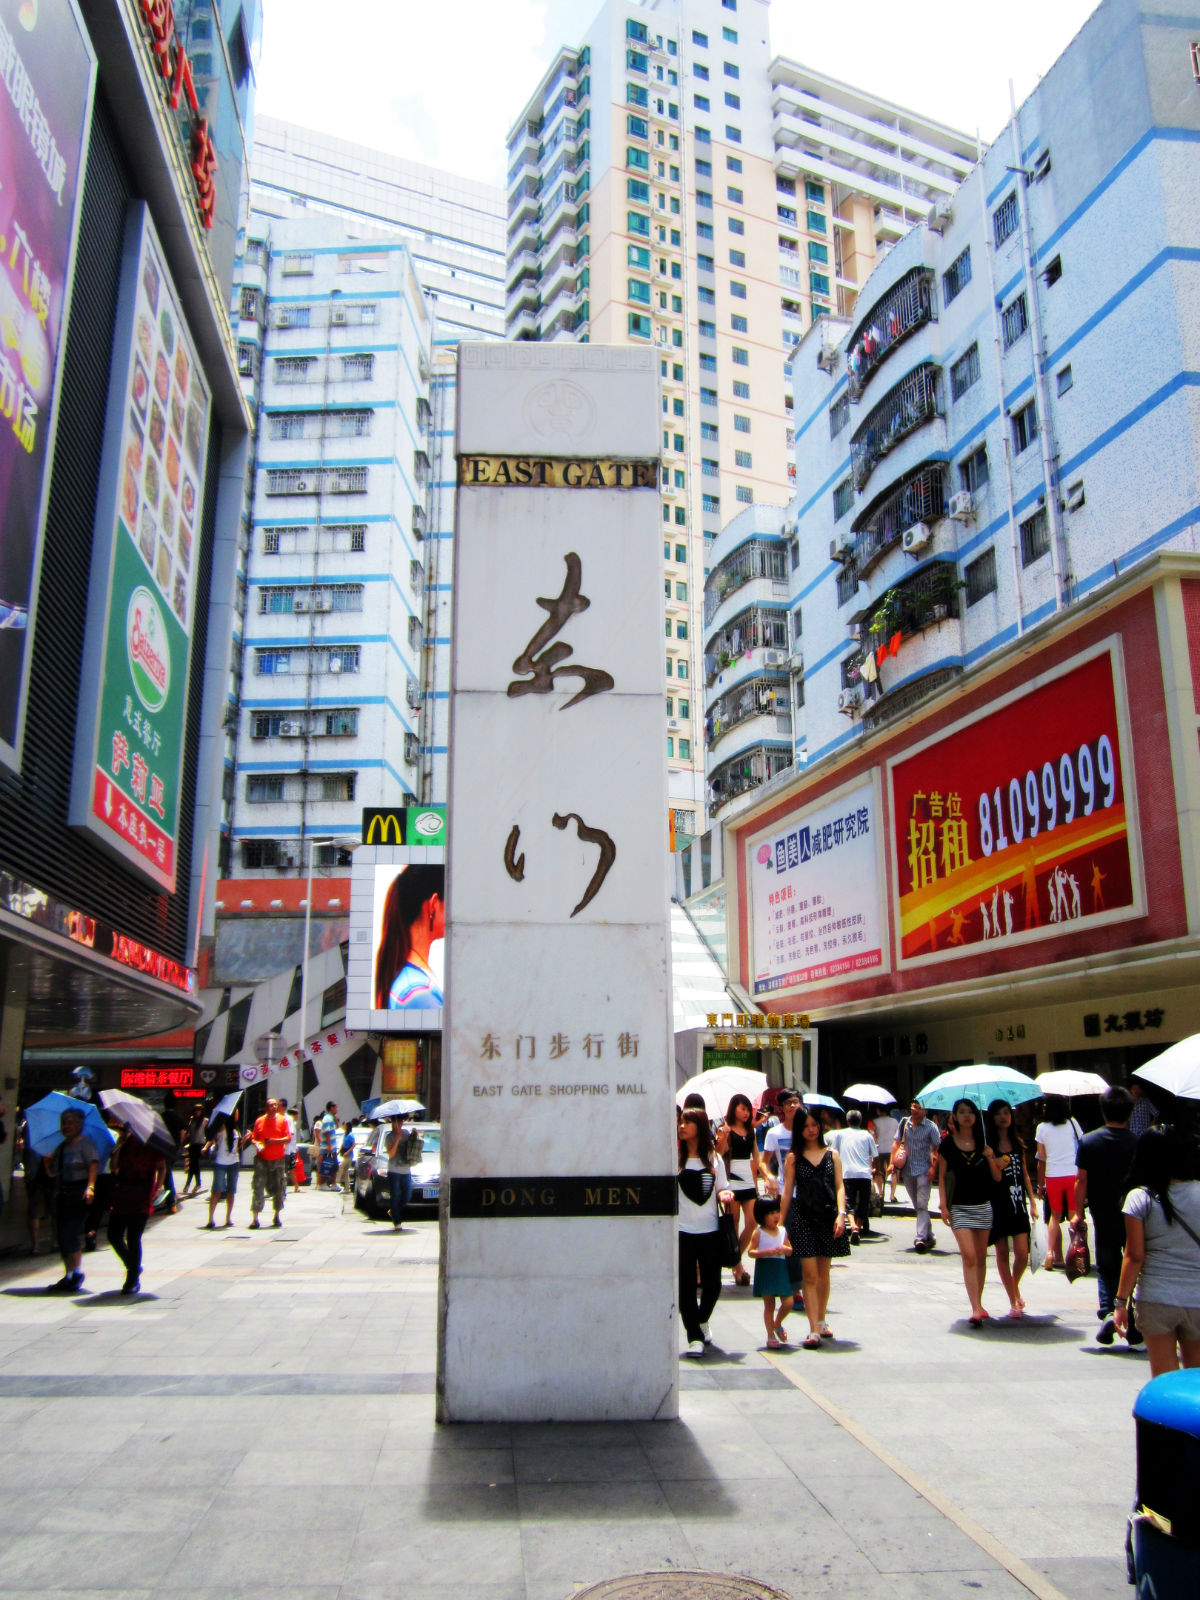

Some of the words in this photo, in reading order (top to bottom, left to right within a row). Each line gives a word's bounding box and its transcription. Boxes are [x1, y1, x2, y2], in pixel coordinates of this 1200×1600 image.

[469, 460, 553, 484] EAST
[561, 462, 650, 487] GATE
[111, 729, 165, 819] 萨莉亚
[912, 789, 963, 818] 广告位
[979, 734, 1115, 857] 81099999
[775, 806, 870, 875] 鱼美人减肥研究院
[907, 818, 976, 892] 招租
[479, 1032, 640, 1060] 东门步行街
[473, 1084, 503, 1097] EAST
[511, 1084, 542, 1097] GATE
[549, 1083, 609, 1097] SHOPPING
[616, 1083, 647, 1096] MALL
[480, 1188, 556, 1208] DONG
[584, 1187, 642, 1207] MEN
